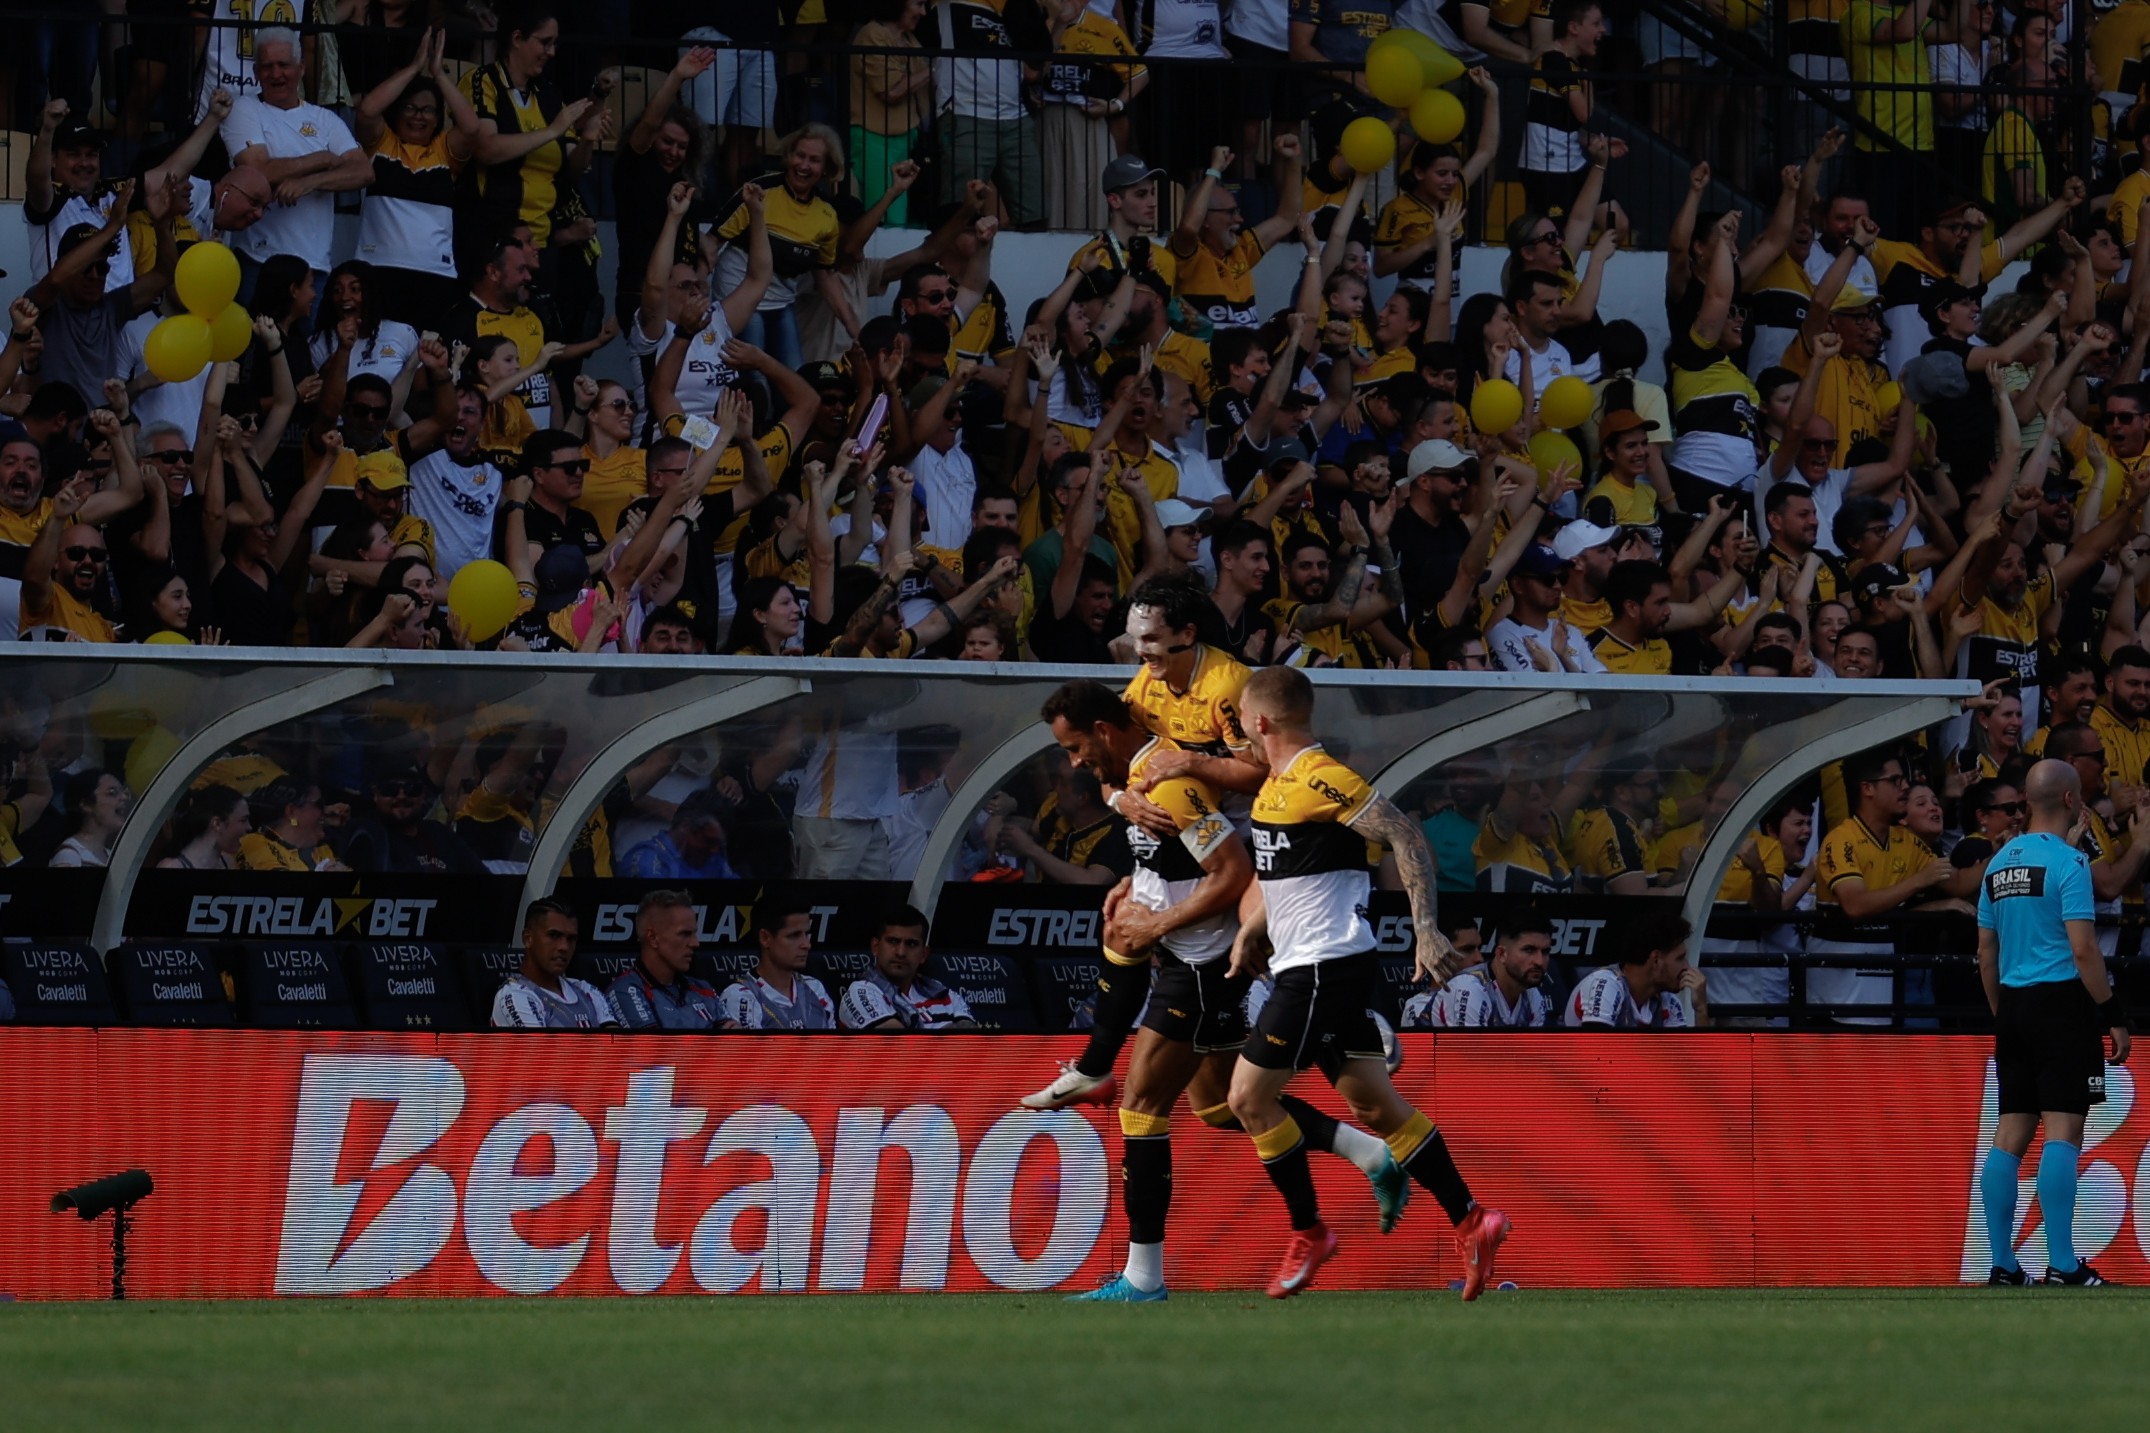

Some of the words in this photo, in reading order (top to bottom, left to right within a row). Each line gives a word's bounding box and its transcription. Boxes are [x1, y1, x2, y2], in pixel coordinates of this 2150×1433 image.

[1992, 868, 2032, 888] BRASIL
[186, 894, 334, 935] ESTRELA
[369, 898, 438, 937] BET
[592, 903, 738, 943] ESLA
[987, 908, 1099, 947] ESTREL
[22, 950, 89, 972] LIVERA
[136, 949, 205, 972] LIVERA
[263, 950, 329, 972] LIVERA
[372, 945, 438, 966] LIVERA
[943, 955, 1008, 977] LIVERA
[37, 983, 87, 1001] Cavaletti
[152, 981, 203, 1000] Cavaletti
[277, 983, 327, 1001] Cavaletti
[387, 977, 436, 996] Cavaletti
[959, 986, 1007, 1005] Cavaletti
[504, 993, 525, 1028] SERME
[843, 995, 866, 1025] ERMED
[1460, 990, 1471, 1027] SERME
[2088, 1077, 2104, 1087] CB
[274, 1053, 1109, 1295] Betano
